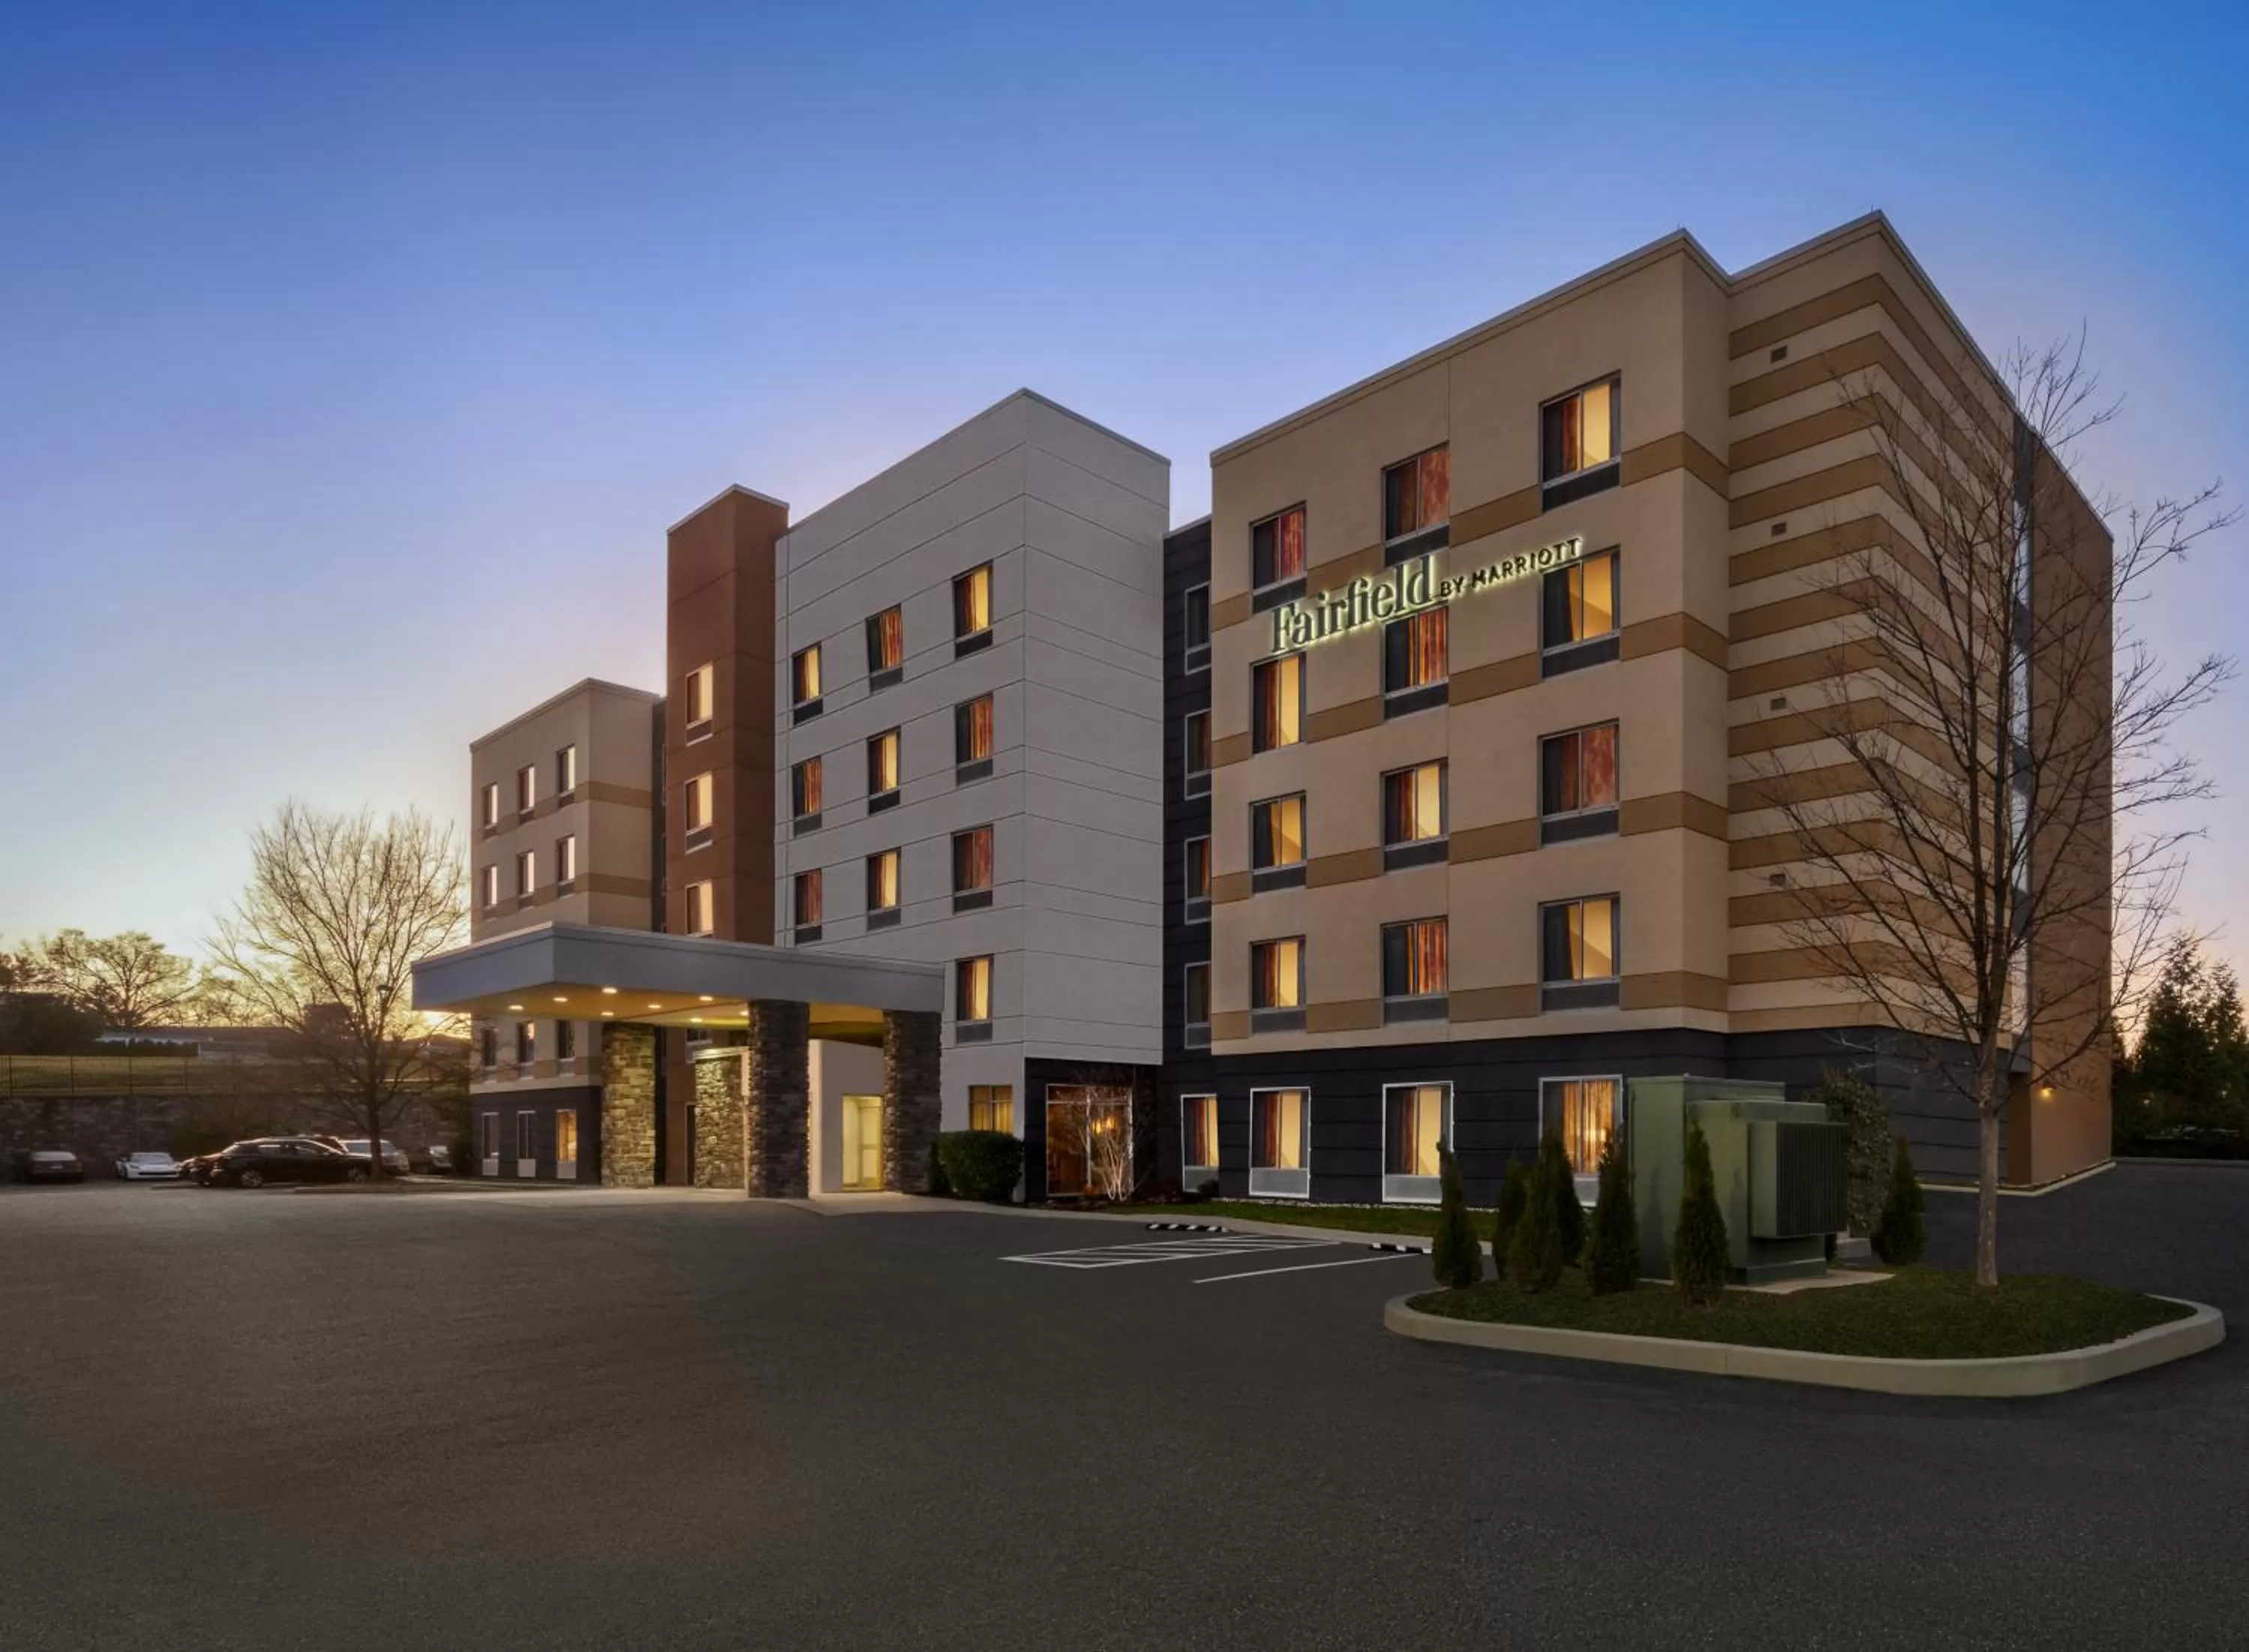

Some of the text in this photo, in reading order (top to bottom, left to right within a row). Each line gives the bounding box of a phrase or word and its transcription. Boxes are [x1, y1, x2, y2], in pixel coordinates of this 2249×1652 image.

[1272, 537, 1582, 655] Fairfield BY MARRIOTT
